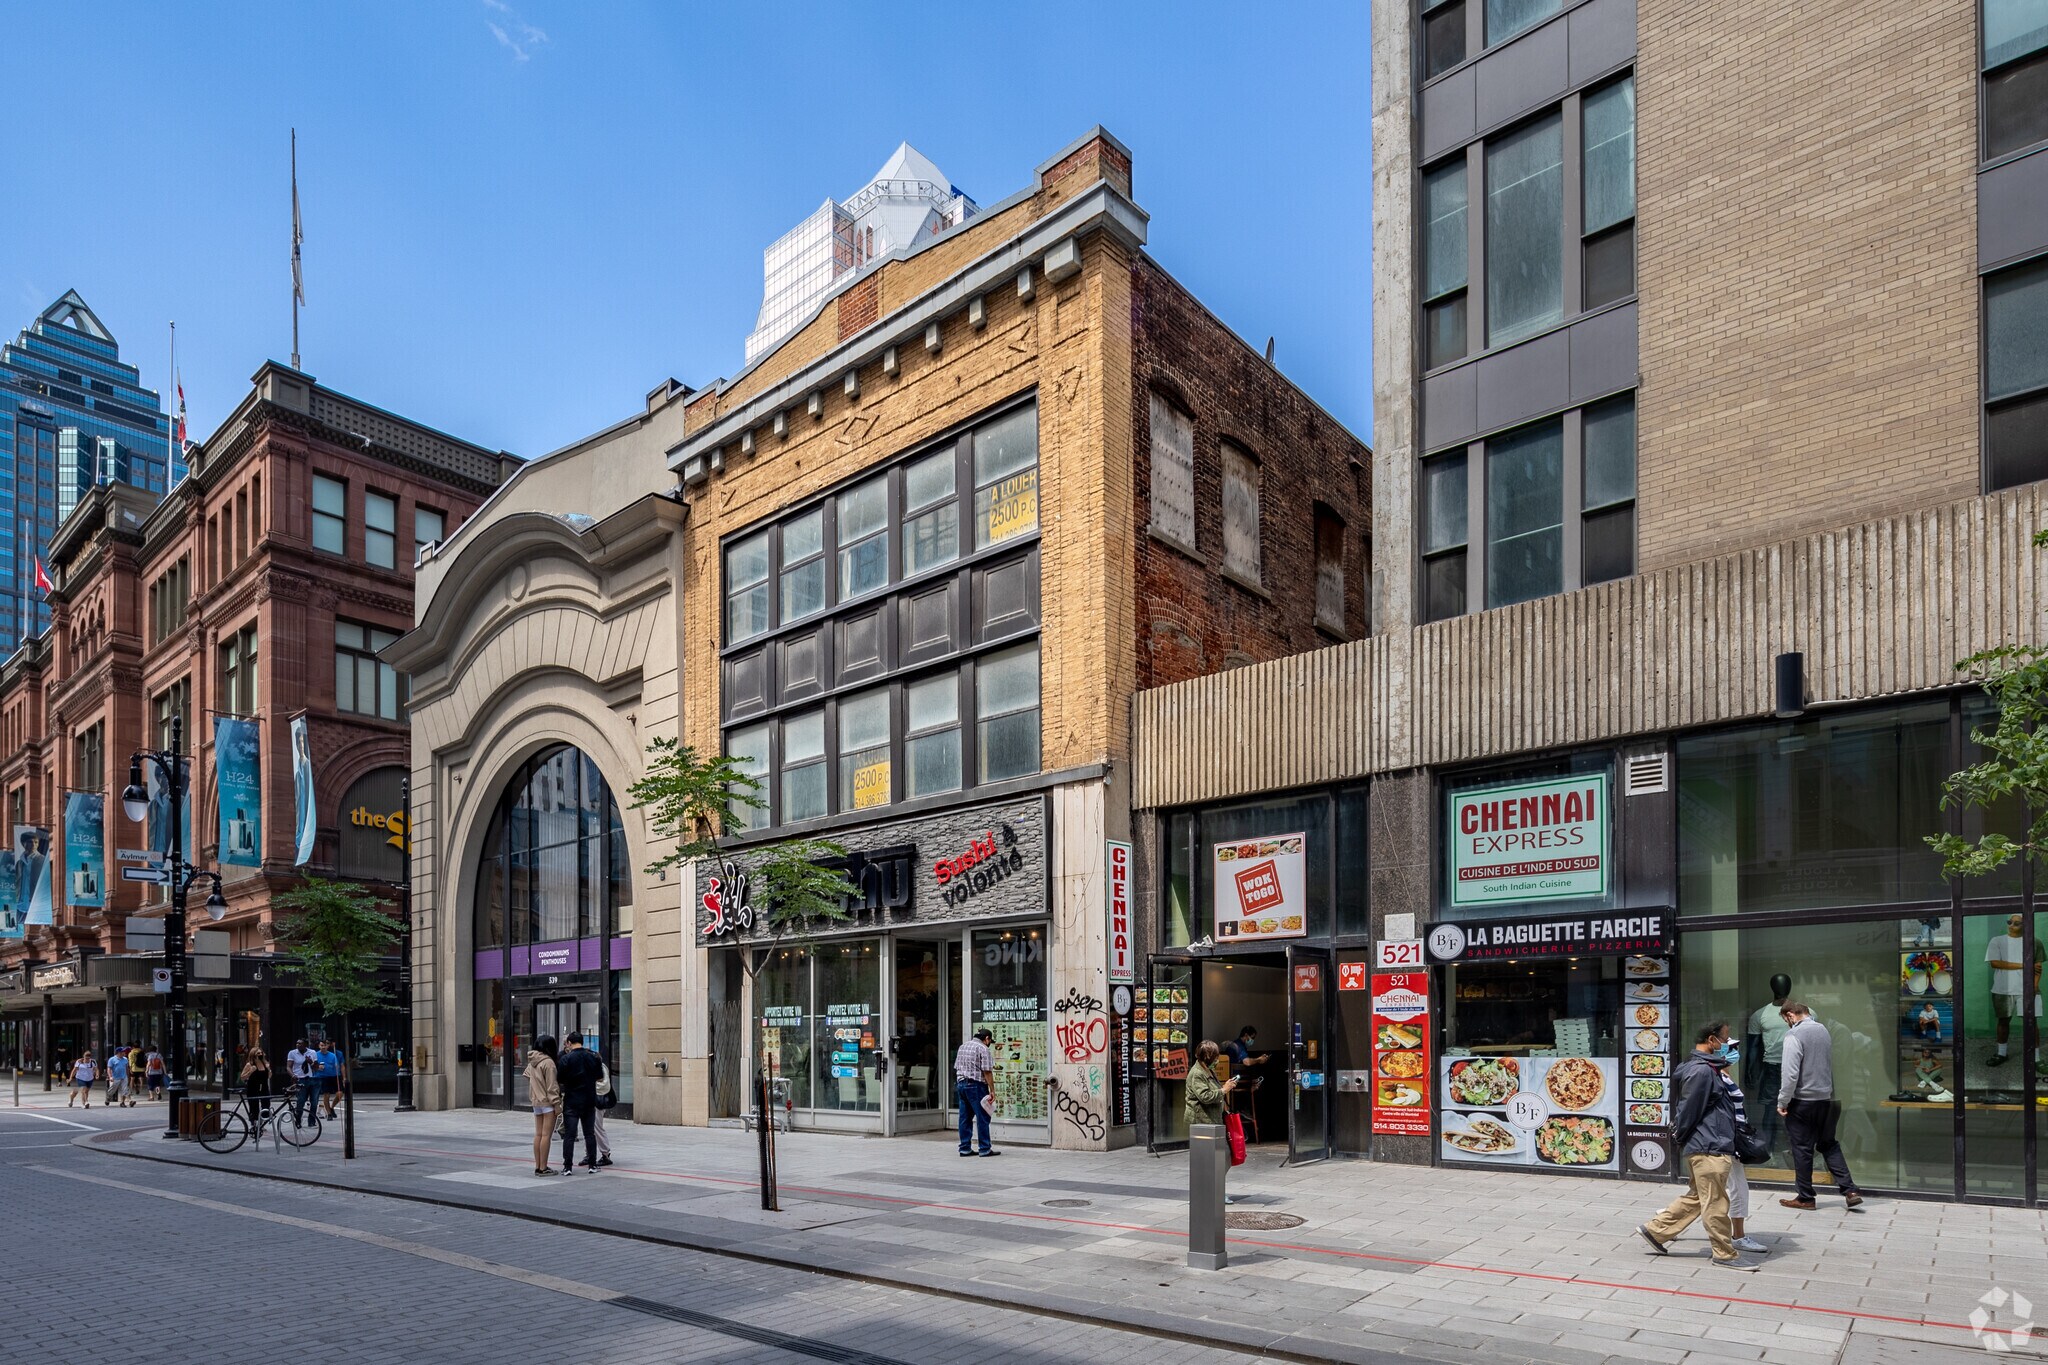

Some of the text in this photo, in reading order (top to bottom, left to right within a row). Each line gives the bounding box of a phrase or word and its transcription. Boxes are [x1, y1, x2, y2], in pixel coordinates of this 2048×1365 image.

[992, 499, 1019, 528] 2500
[226, 770, 255, 784] H24
[856, 768, 877, 790] 2500
[1460, 788, 1595, 836] CHENNAI
[73, 833, 98, 844] H24
[1472, 826, 1585, 856] EXPRESS
[120, 853, 149, 861] Aylmer
[933, 830, 998, 885] Sushi
[942, 846, 1023, 908] volonté
[1460, 857, 1598, 879] CUISINE DE L'INDE DU SUD
[1242, 872, 1273, 892] WOK
[1483, 878, 1572, 893] South Indian Cuisine
[1245, 884, 1276, 904] TOGO
[1112, 847, 1128, 966] CHENNAI
[1467, 916, 1661, 946] LA BAGUETTE FARCIE
[538, 949, 570, 959] CONDOMINIUMS
[1382, 943, 1420, 965] 521
[1467, 944, 1574, 957] SANDWICHERIE
[1589, 939, 1661, 951] PIZZERIA
[541, 957, 567, 966] PENTHOUSES
[1111, 969, 1132, 978] EXPRESS
[1390, 974, 1409, 986] 521
[1380, 994, 1420, 1004] CHENNAI
[827, 1003, 870, 1016] APPORTEZ VOTRE VIN
[1121, 1017, 1131, 1124] LA BAGUETTE FARCIE
